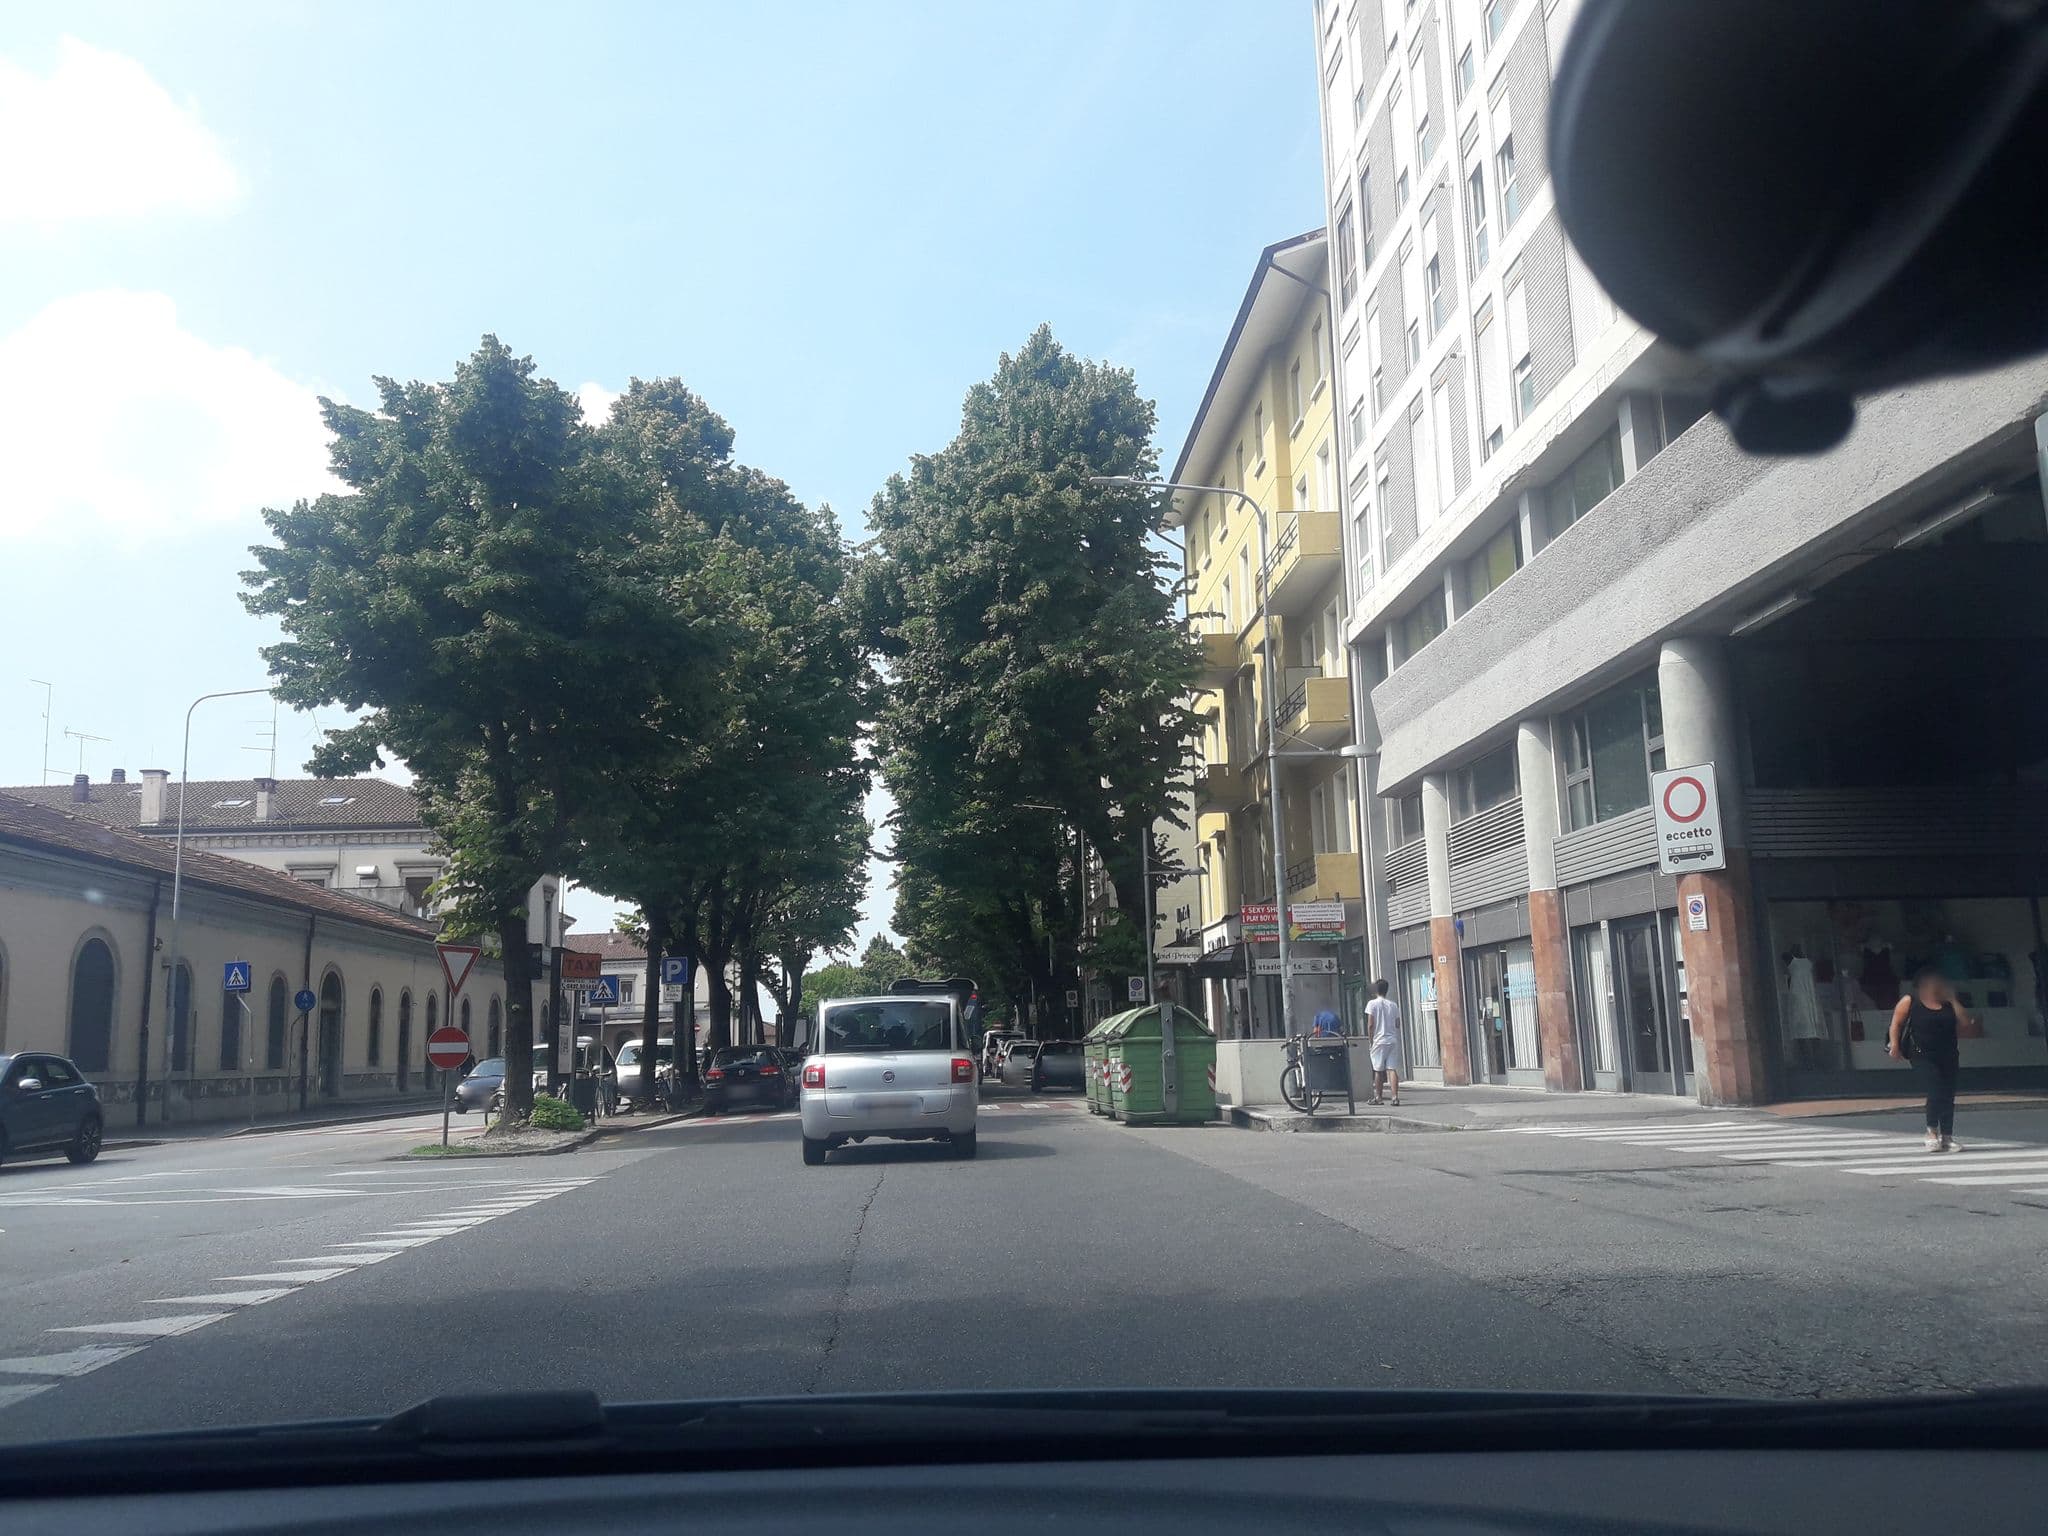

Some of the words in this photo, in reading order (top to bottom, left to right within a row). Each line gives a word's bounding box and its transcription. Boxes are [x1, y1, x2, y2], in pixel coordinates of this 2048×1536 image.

[1666, 827, 1712, 841] eccetto
[1248, 906, 1265, 914] SEXY
[565, 959, 601, 972] TAXI
[666, 960, 683, 981] P
